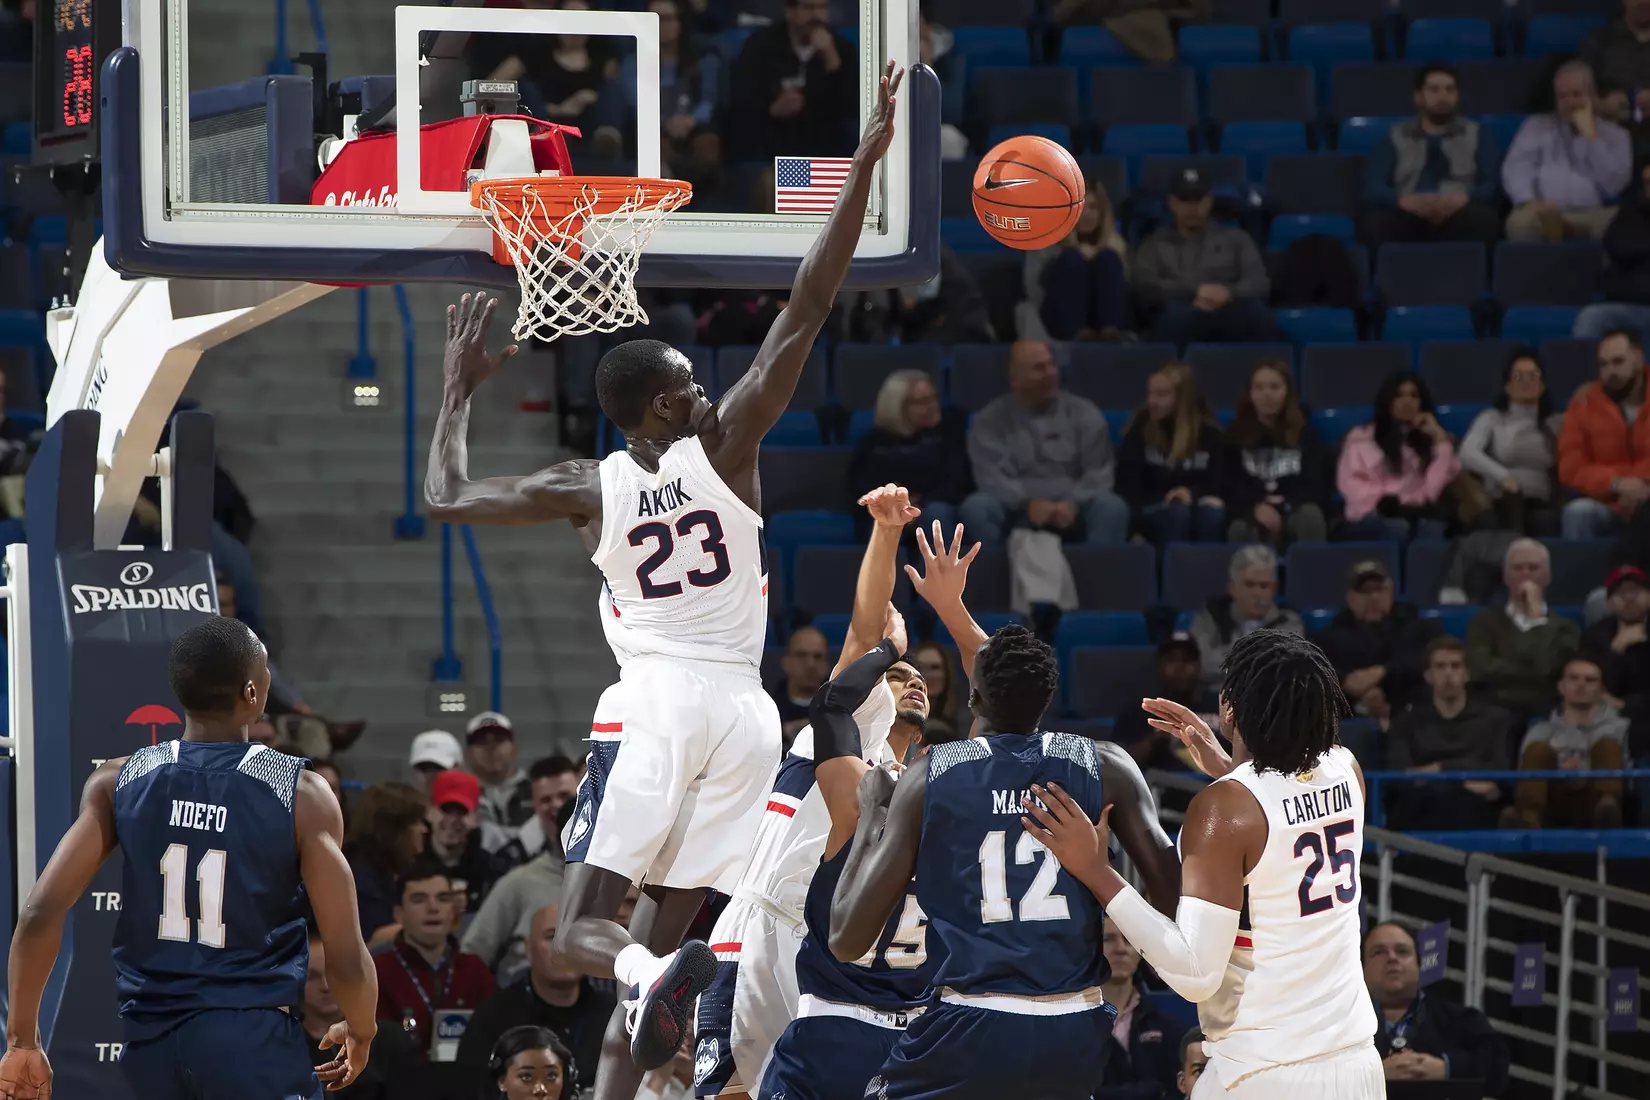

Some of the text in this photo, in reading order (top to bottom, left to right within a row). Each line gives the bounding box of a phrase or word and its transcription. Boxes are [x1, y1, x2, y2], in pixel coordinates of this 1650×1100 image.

[638, 477, 693, 517] AKOK
[627, 509, 732, 600] 23
[71, 583, 212, 613] SPALDING
[169, 800, 227, 833] NDEFO
[1283, 781, 1352, 826] CARLTON
[158, 843, 227, 948] 11
[979, 829, 1071, 924] 12
[1293, 819, 1357, 918] 25
[91, 892, 123, 911] TR
[850, 894, 929, 970] 5
